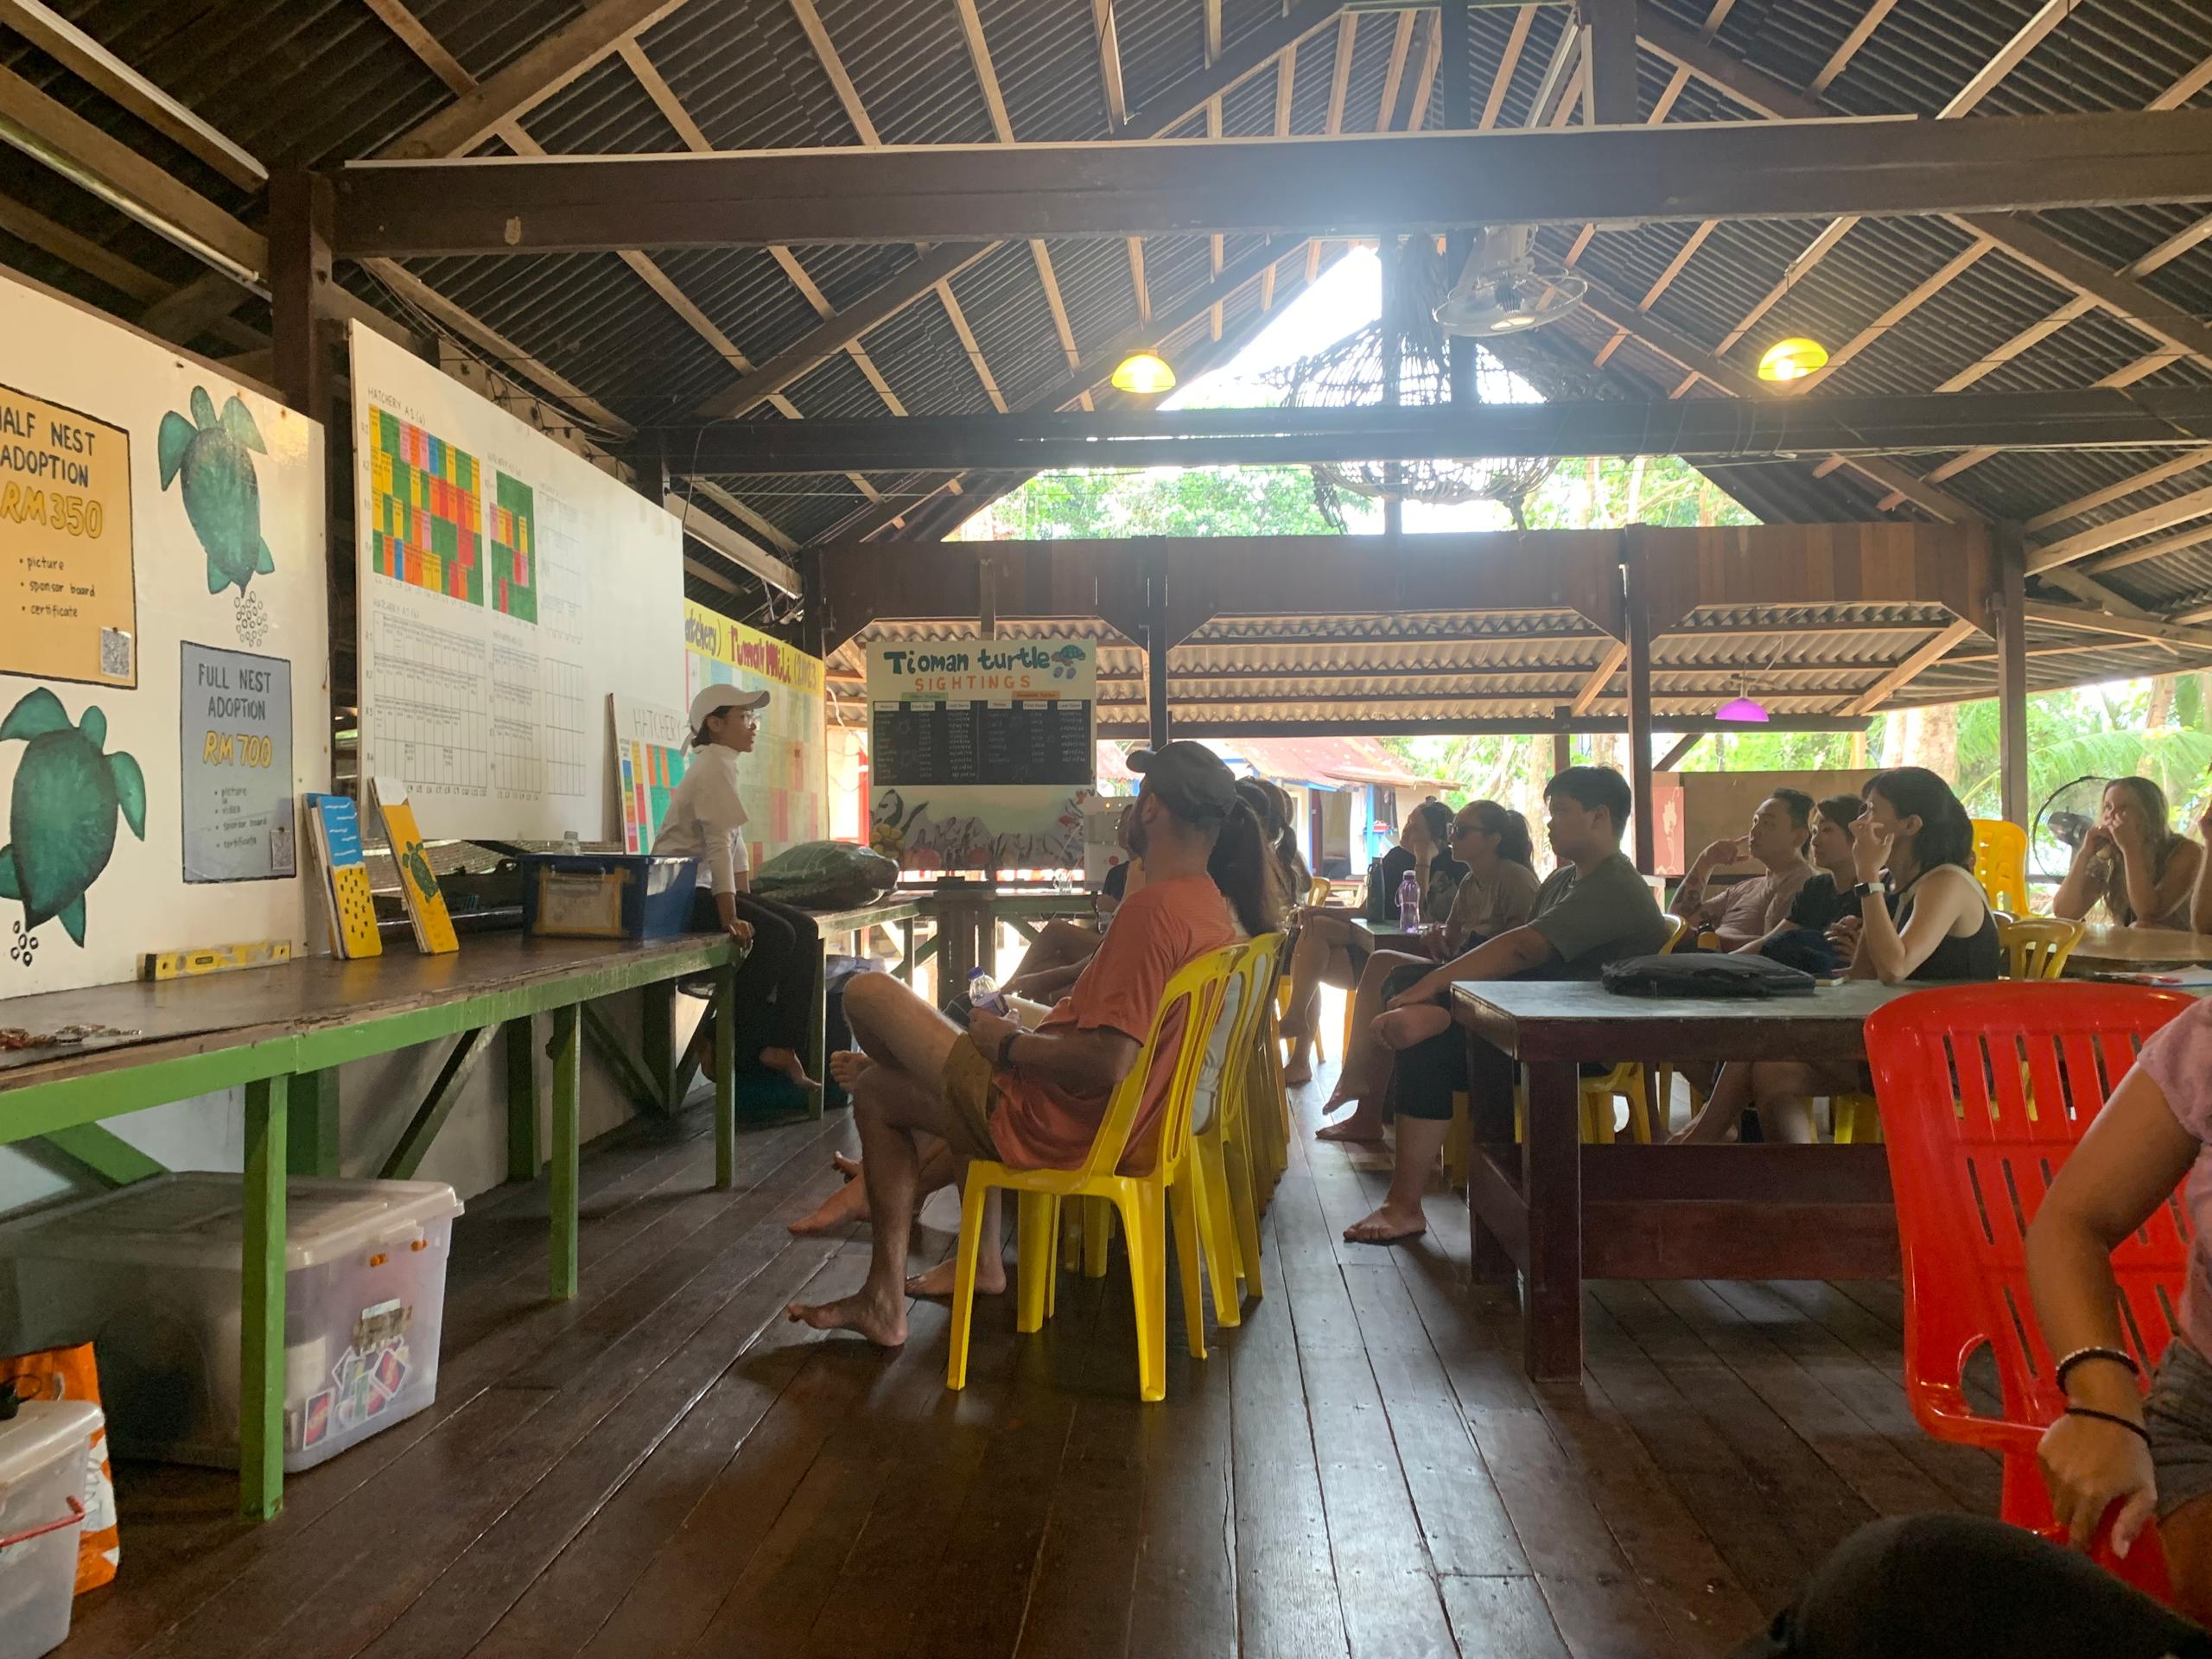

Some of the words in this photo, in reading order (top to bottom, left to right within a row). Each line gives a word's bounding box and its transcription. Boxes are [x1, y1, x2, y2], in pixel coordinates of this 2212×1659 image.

[367, 386, 401, 410] HATCHERY
[50, 421, 96, 457] NEST
[0, 444, 89, 488] ADOPTION
[0, 480, 103, 539] RM350
[27, 556, 64, 571] picture
[29, 580, 64, 593] sponsor
[70, 583, 96, 597] board
[30, 604, 78, 618] certificate
[883, 651, 969, 675] Tioman
[977, 646, 1051, 671] turtle
[199, 664, 230, 690] FULL
[239, 669, 271, 694] NEST
[914, 675, 1031, 692] SIGHTINGS
[208, 696, 266, 721] ADOPTION
[203, 730, 273, 768] RM700
